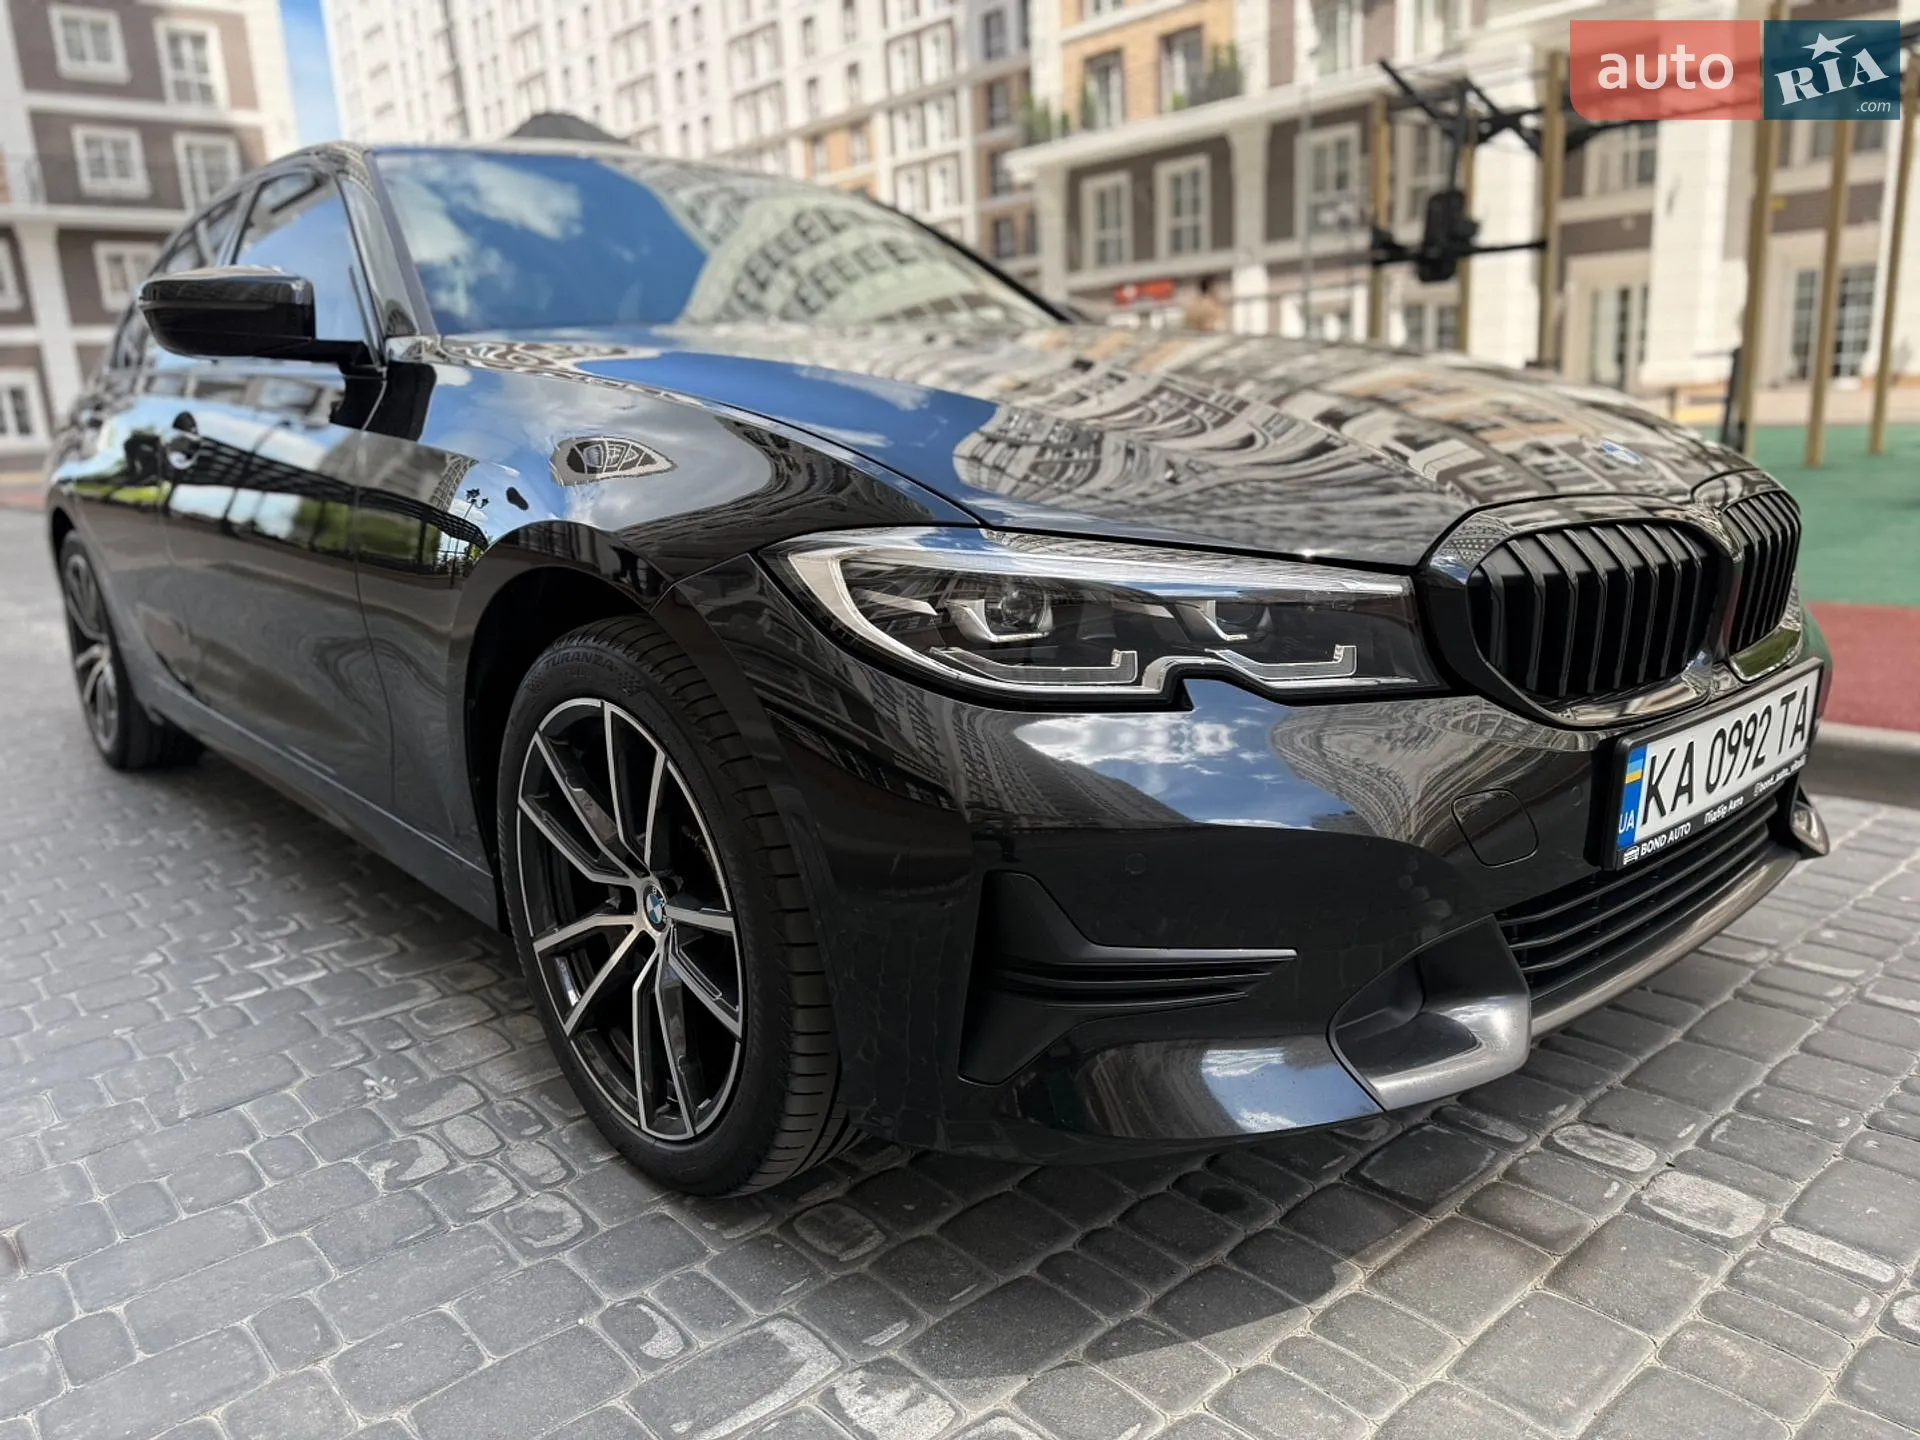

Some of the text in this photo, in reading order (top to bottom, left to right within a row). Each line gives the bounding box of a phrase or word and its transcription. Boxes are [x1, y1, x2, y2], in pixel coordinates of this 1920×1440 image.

[543, 651, 615, 672] TURANZA
[1642, 685, 1809, 826] KA 0992 TA
[1618, 809, 1635, 834] UA
[1640, 822, 1691, 857] BOND AUTO
